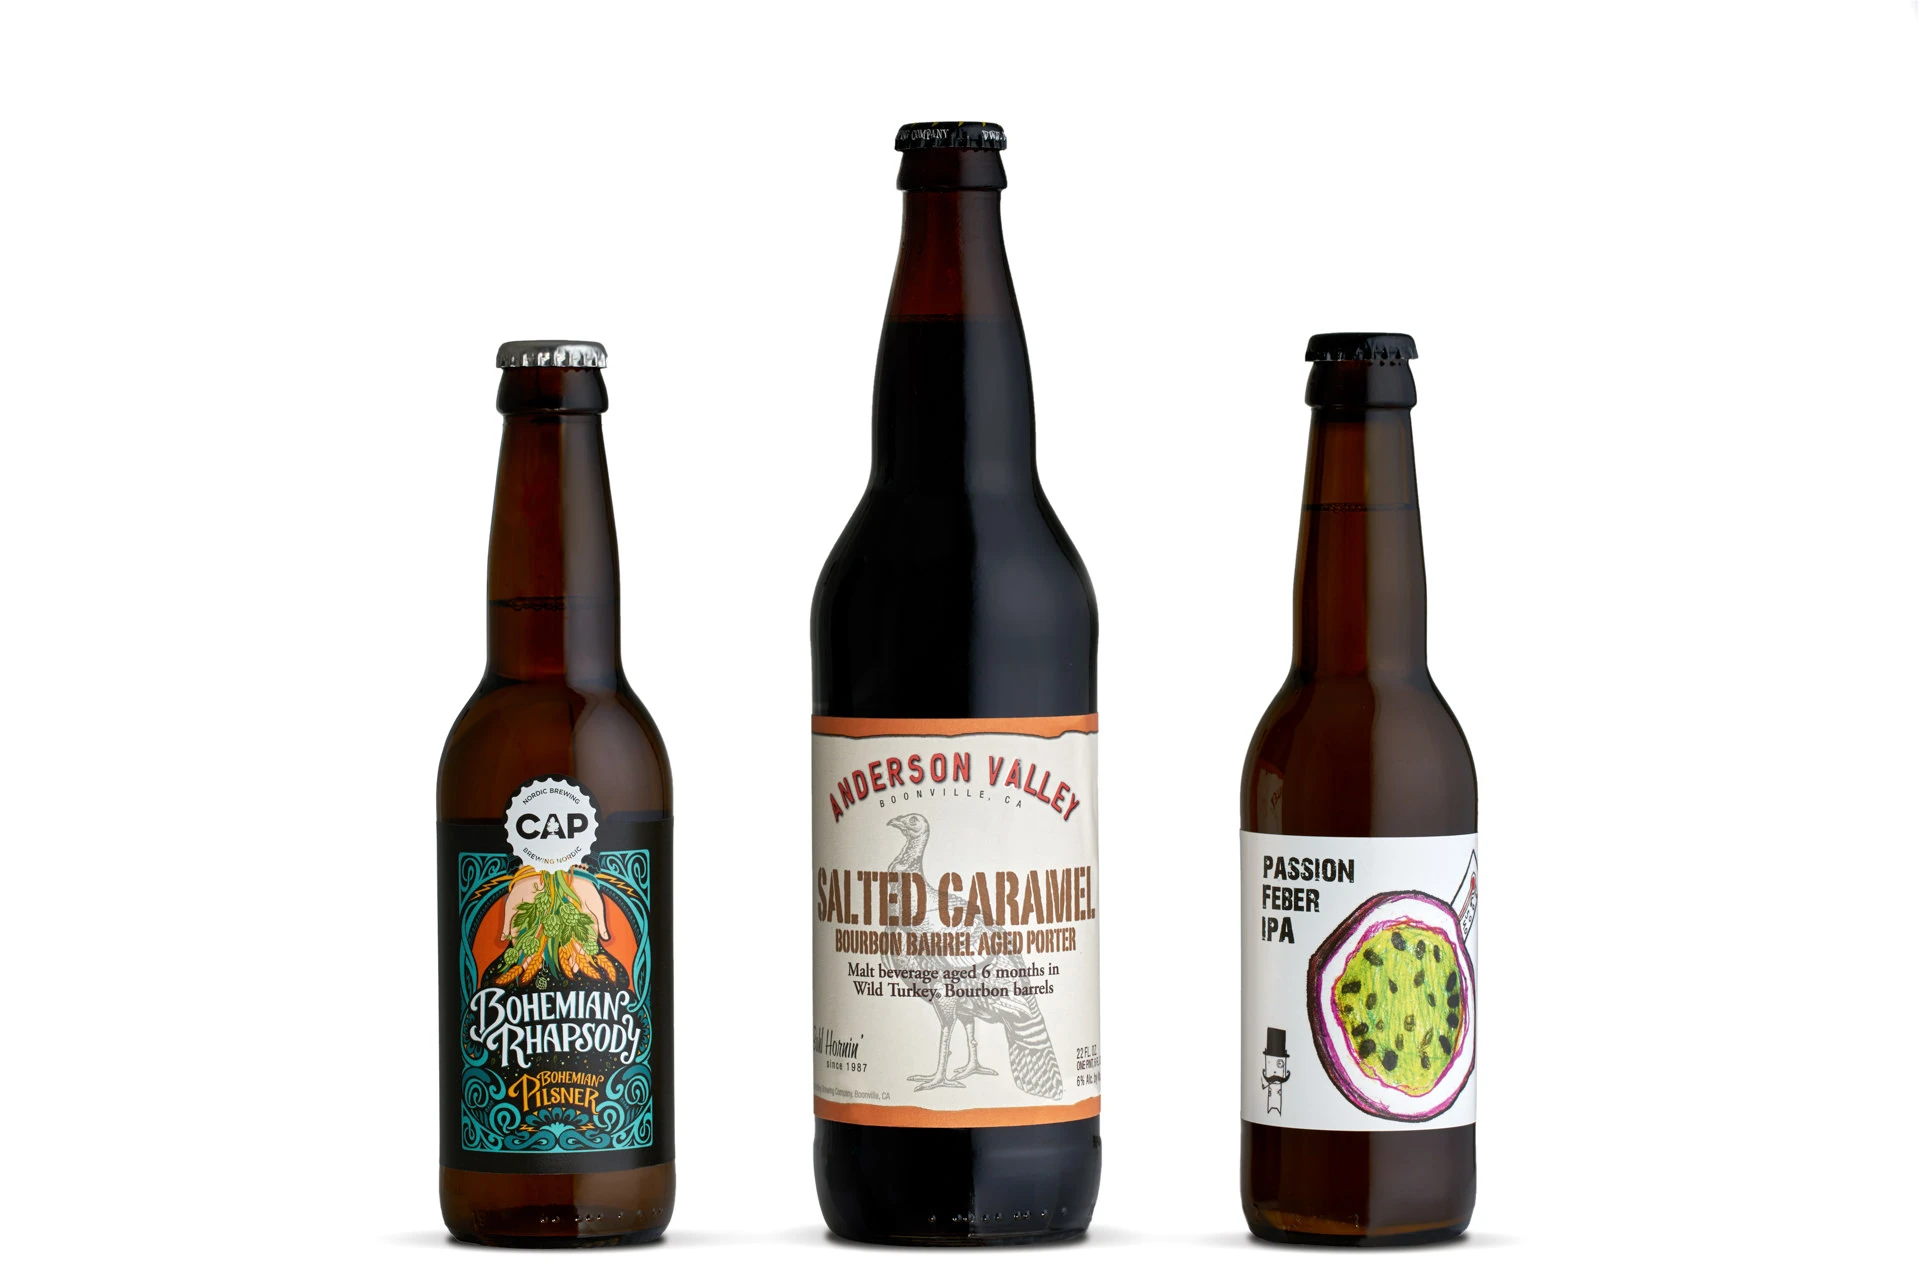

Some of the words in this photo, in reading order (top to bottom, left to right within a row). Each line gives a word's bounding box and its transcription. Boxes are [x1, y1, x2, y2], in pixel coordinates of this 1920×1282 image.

[523, 788, 548, 805] NORDIC
[549, 787, 581, 805] BREWING
[829, 752, 970, 824] ANDERSON
[988, 755, 1081, 822] VALLEY
[1004, 795, 1022, 808] CA
[515, 812, 589, 840] CAP
[522, 847, 555, 865] BREWING
[556, 846, 582, 864] NORDIC
[1263, 855, 1355, 883] PASSION
[817, 866, 927, 927] SALTED
[938, 865, 1096, 928] CARAMEL
[1262, 884, 1320, 912] FEBER
[835, 928, 902, 956] BOURBON
[906, 931, 975, 956] BARREL
[978, 931, 1024, 956] AGED
[1026, 926, 1076, 955] PORTER
[1261, 916, 1296, 944] IPA
[847, 962, 875, 978] Malt
[878, 963, 938, 984] beverage
[943, 964, 977, 985] aged
[981, 964, 991, 979] 6
[995, 962, 1045, 979] months
[1048, 962, 1060, 976] in
[853, 981, 883, 997] Wild
[945, 982, 1009, 998] Bourbon
[1013, 979, 1054, 997] barrels
[469, 987, 630, 1043] BOHEMIAN
[486, 1014, 642, 1069] RHAPSODY
[1077, 1047, 1083, 1059] 22
[826, 1059, 843, 1070] since
[846, 1062, 868, 1073] 1987
[1077, 1060, 1086, 1071] ONE
[537, 1071, 605, 1088] BOHEMIAN
[507, 1073, 600, 1115] PILSNER
[881, 1091, 891, 1101] CA
